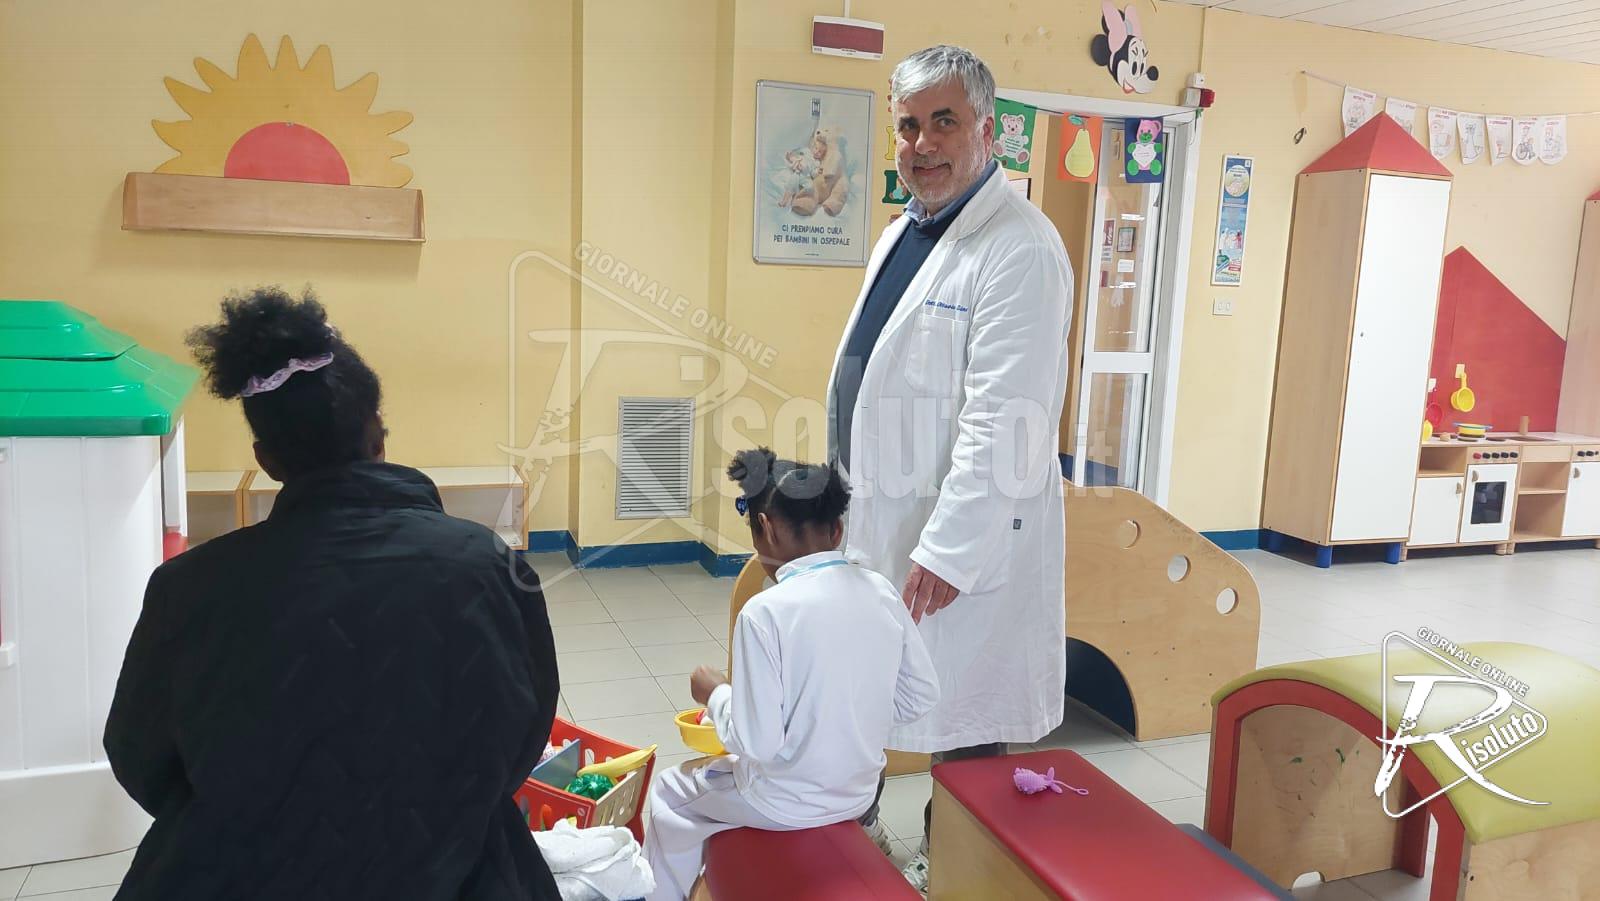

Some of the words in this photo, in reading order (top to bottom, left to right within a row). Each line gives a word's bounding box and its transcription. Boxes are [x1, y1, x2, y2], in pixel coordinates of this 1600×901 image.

[782, 224, 788, 232] CI
[791, 225, 824, 234] PRENDIAMO
[827, 227, 843, 235] CURA
[786, 235, 809, 244] BAMBINI
[812, 236, 817, 244] IN
[821, 237, 850, 246] OSPEDALE
